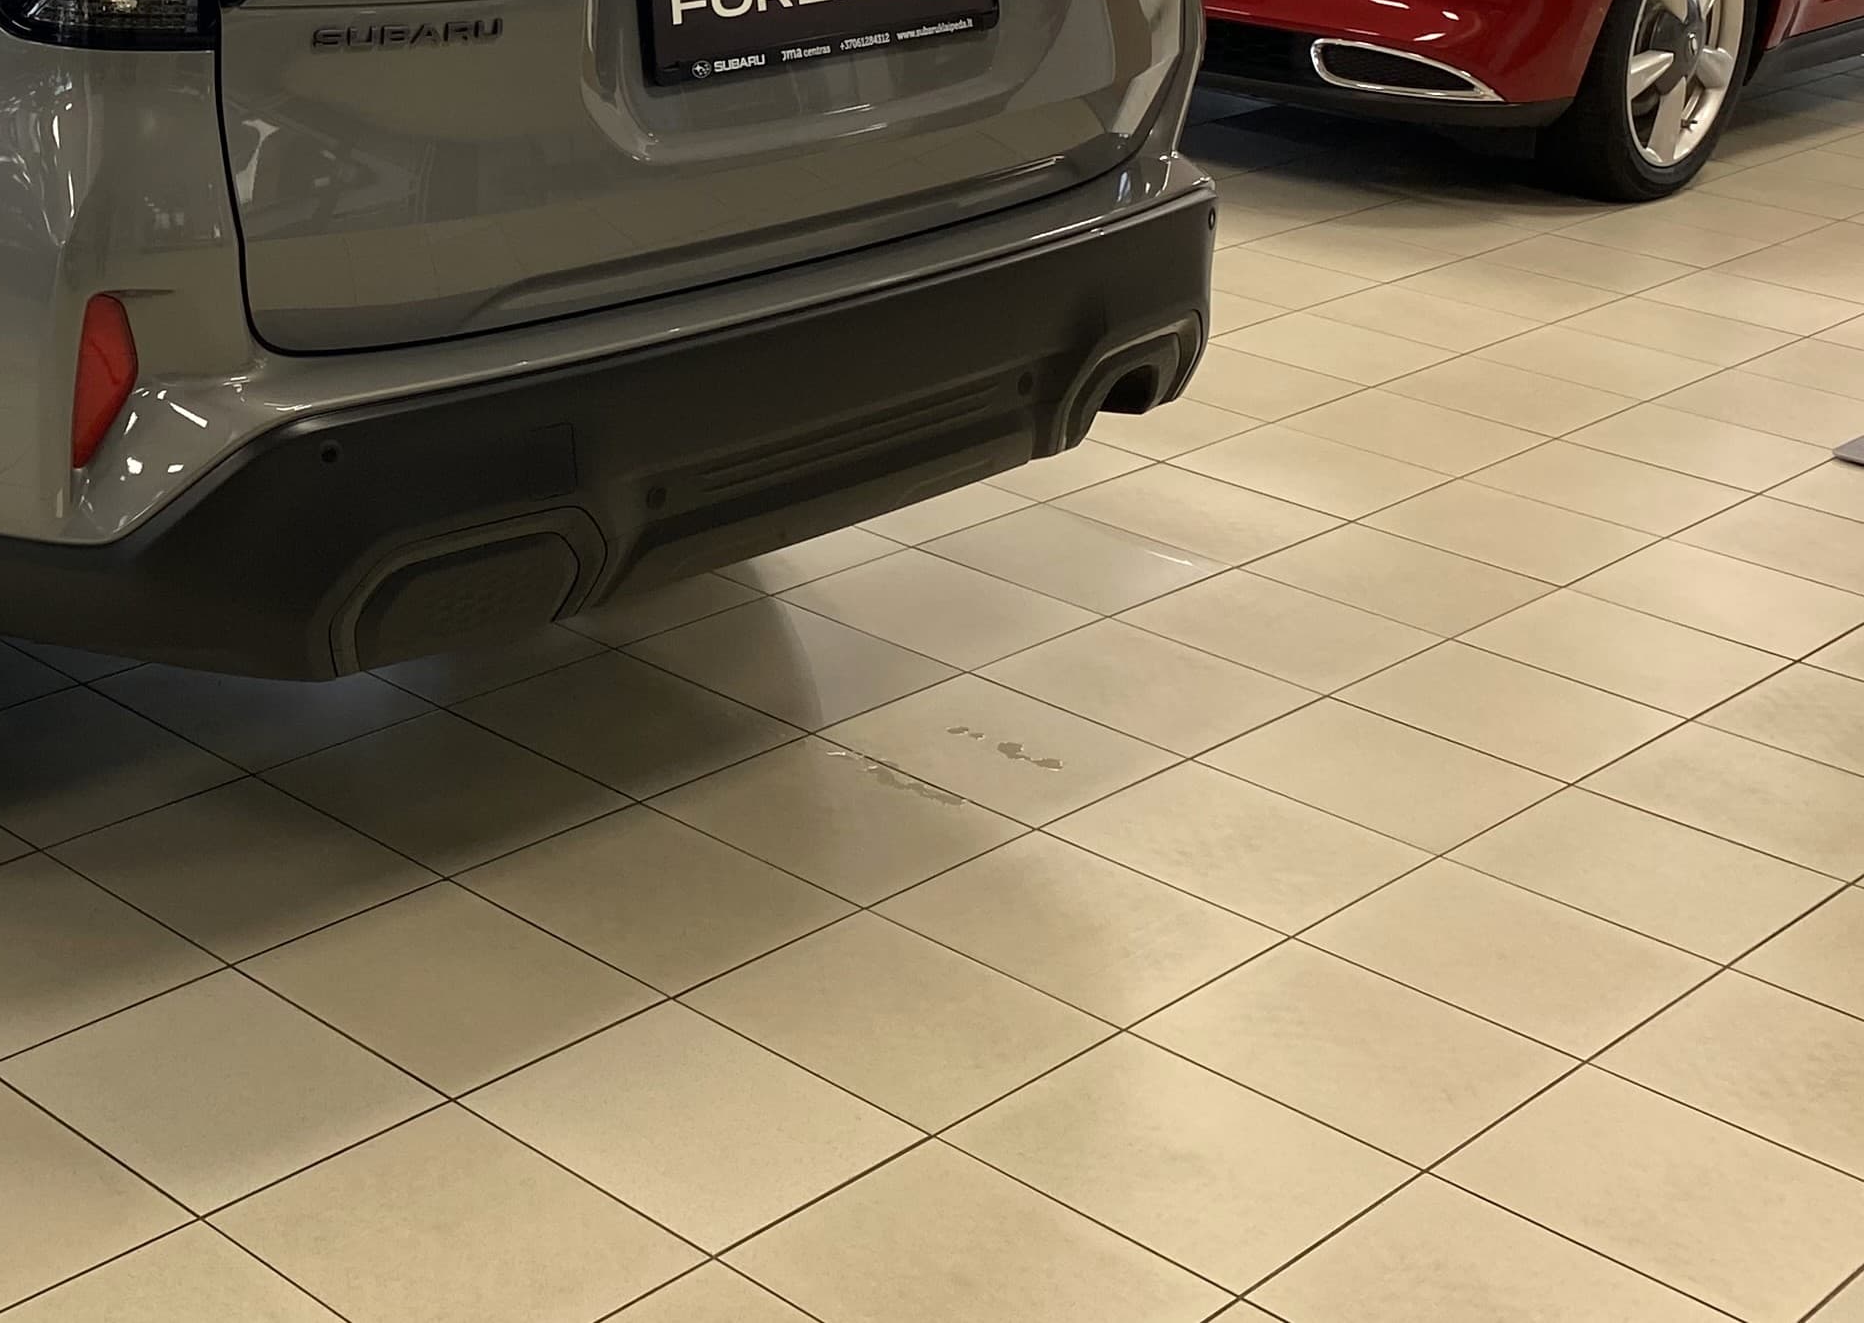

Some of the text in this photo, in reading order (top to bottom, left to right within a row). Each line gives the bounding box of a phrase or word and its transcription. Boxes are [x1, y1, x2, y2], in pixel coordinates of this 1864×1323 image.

[312, 18, 503, 49] SUBARU
[713, 53, 766, 74] SUBARU
[803, 45, 832, 57] centras
